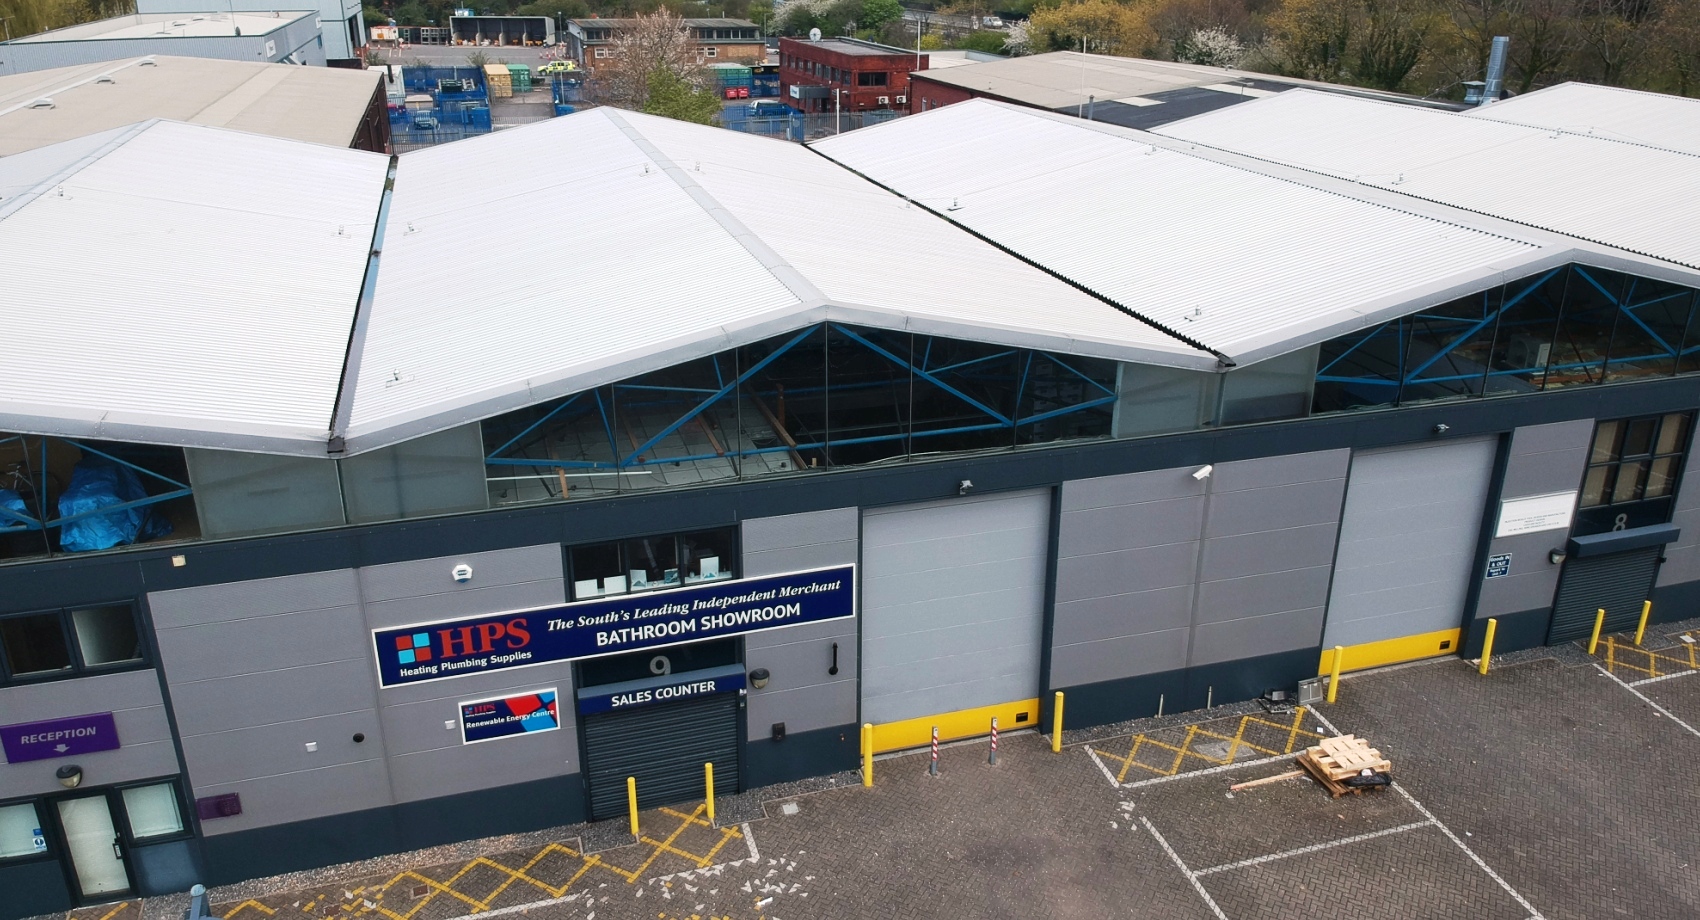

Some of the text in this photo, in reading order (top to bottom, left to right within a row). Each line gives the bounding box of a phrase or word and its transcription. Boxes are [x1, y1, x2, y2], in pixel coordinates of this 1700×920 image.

[1612, 513, 1627, 532] 8
[547, 619, 575, 632] The
[633, 603, 689, 620] Leading
[692, 589, 776, 611] Independent
[778, 579, 841, 598] Merchant
[596, 602, 801, 647] BATHROOM SHOWROOM
[437, 618, 531, 658] HPS
[400, 651, 532, 677] Heating Plumbing Supplies
[649, 655, 672, 676] 9
[611, 680, 716, 707] SALES COUNTER
[466, 717, 505, 728] Renewable
[506, 713, 531, 722] Energy
[531, 709, 555, 718] Centre
[474, 704, 495, 713] HPS
[21, 726, 97, 744] RECEPTION
